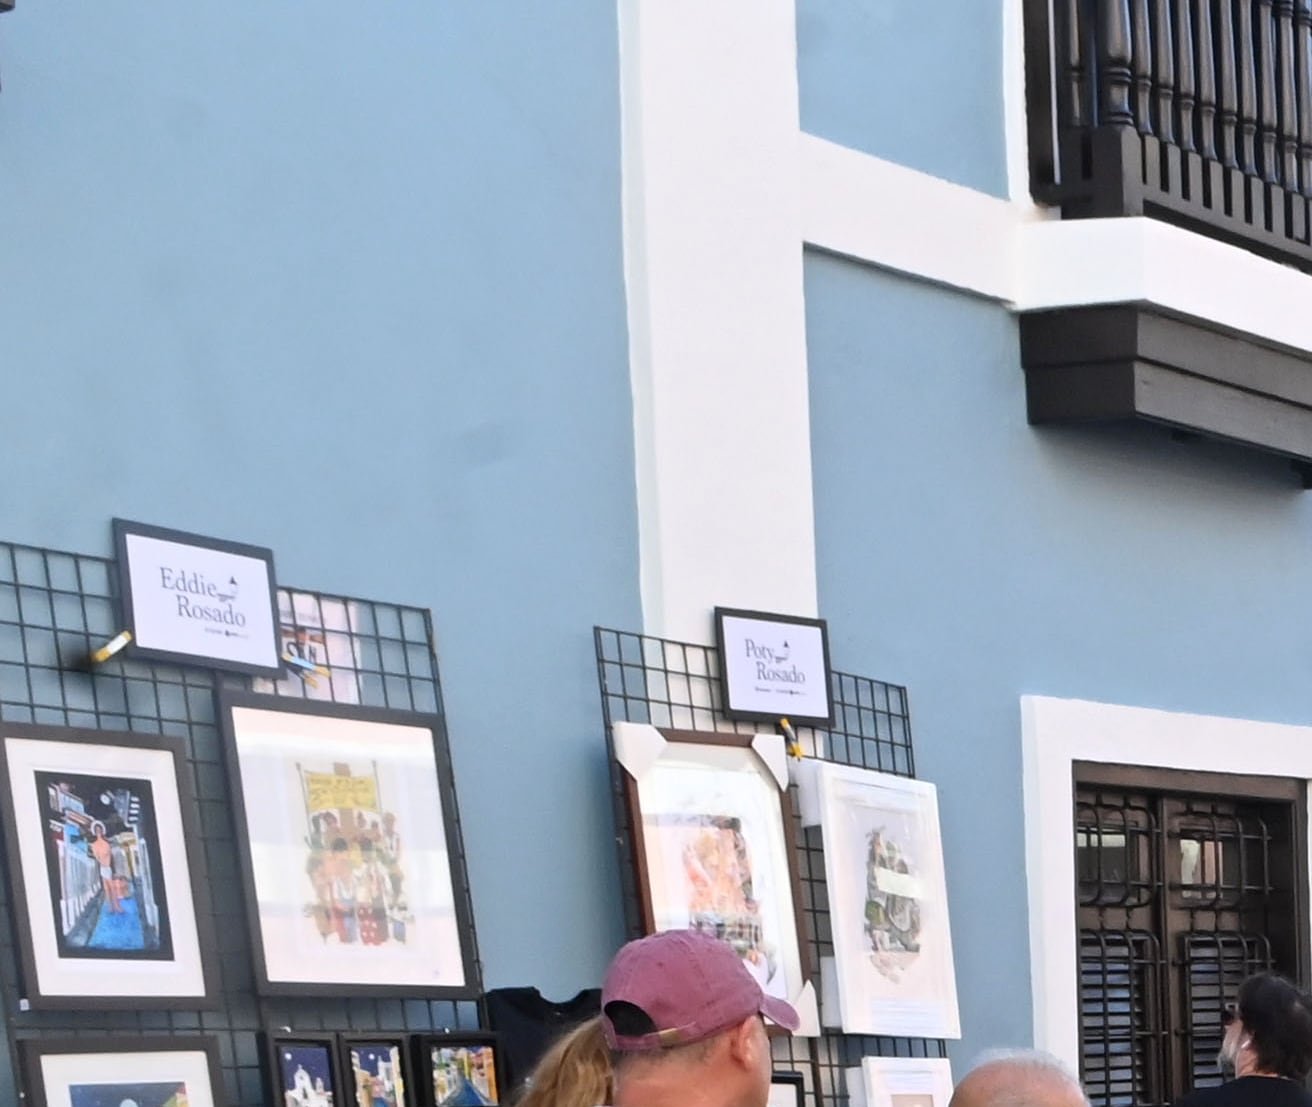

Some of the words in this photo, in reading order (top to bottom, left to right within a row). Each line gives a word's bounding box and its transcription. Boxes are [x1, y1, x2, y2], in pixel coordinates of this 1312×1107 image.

[159, 566, 217, 598] Eddie
[176, 594, 246, 627] Rosado
[744, 638, 775, 664] Poty
[756, 661, 806, 684] Rosado
